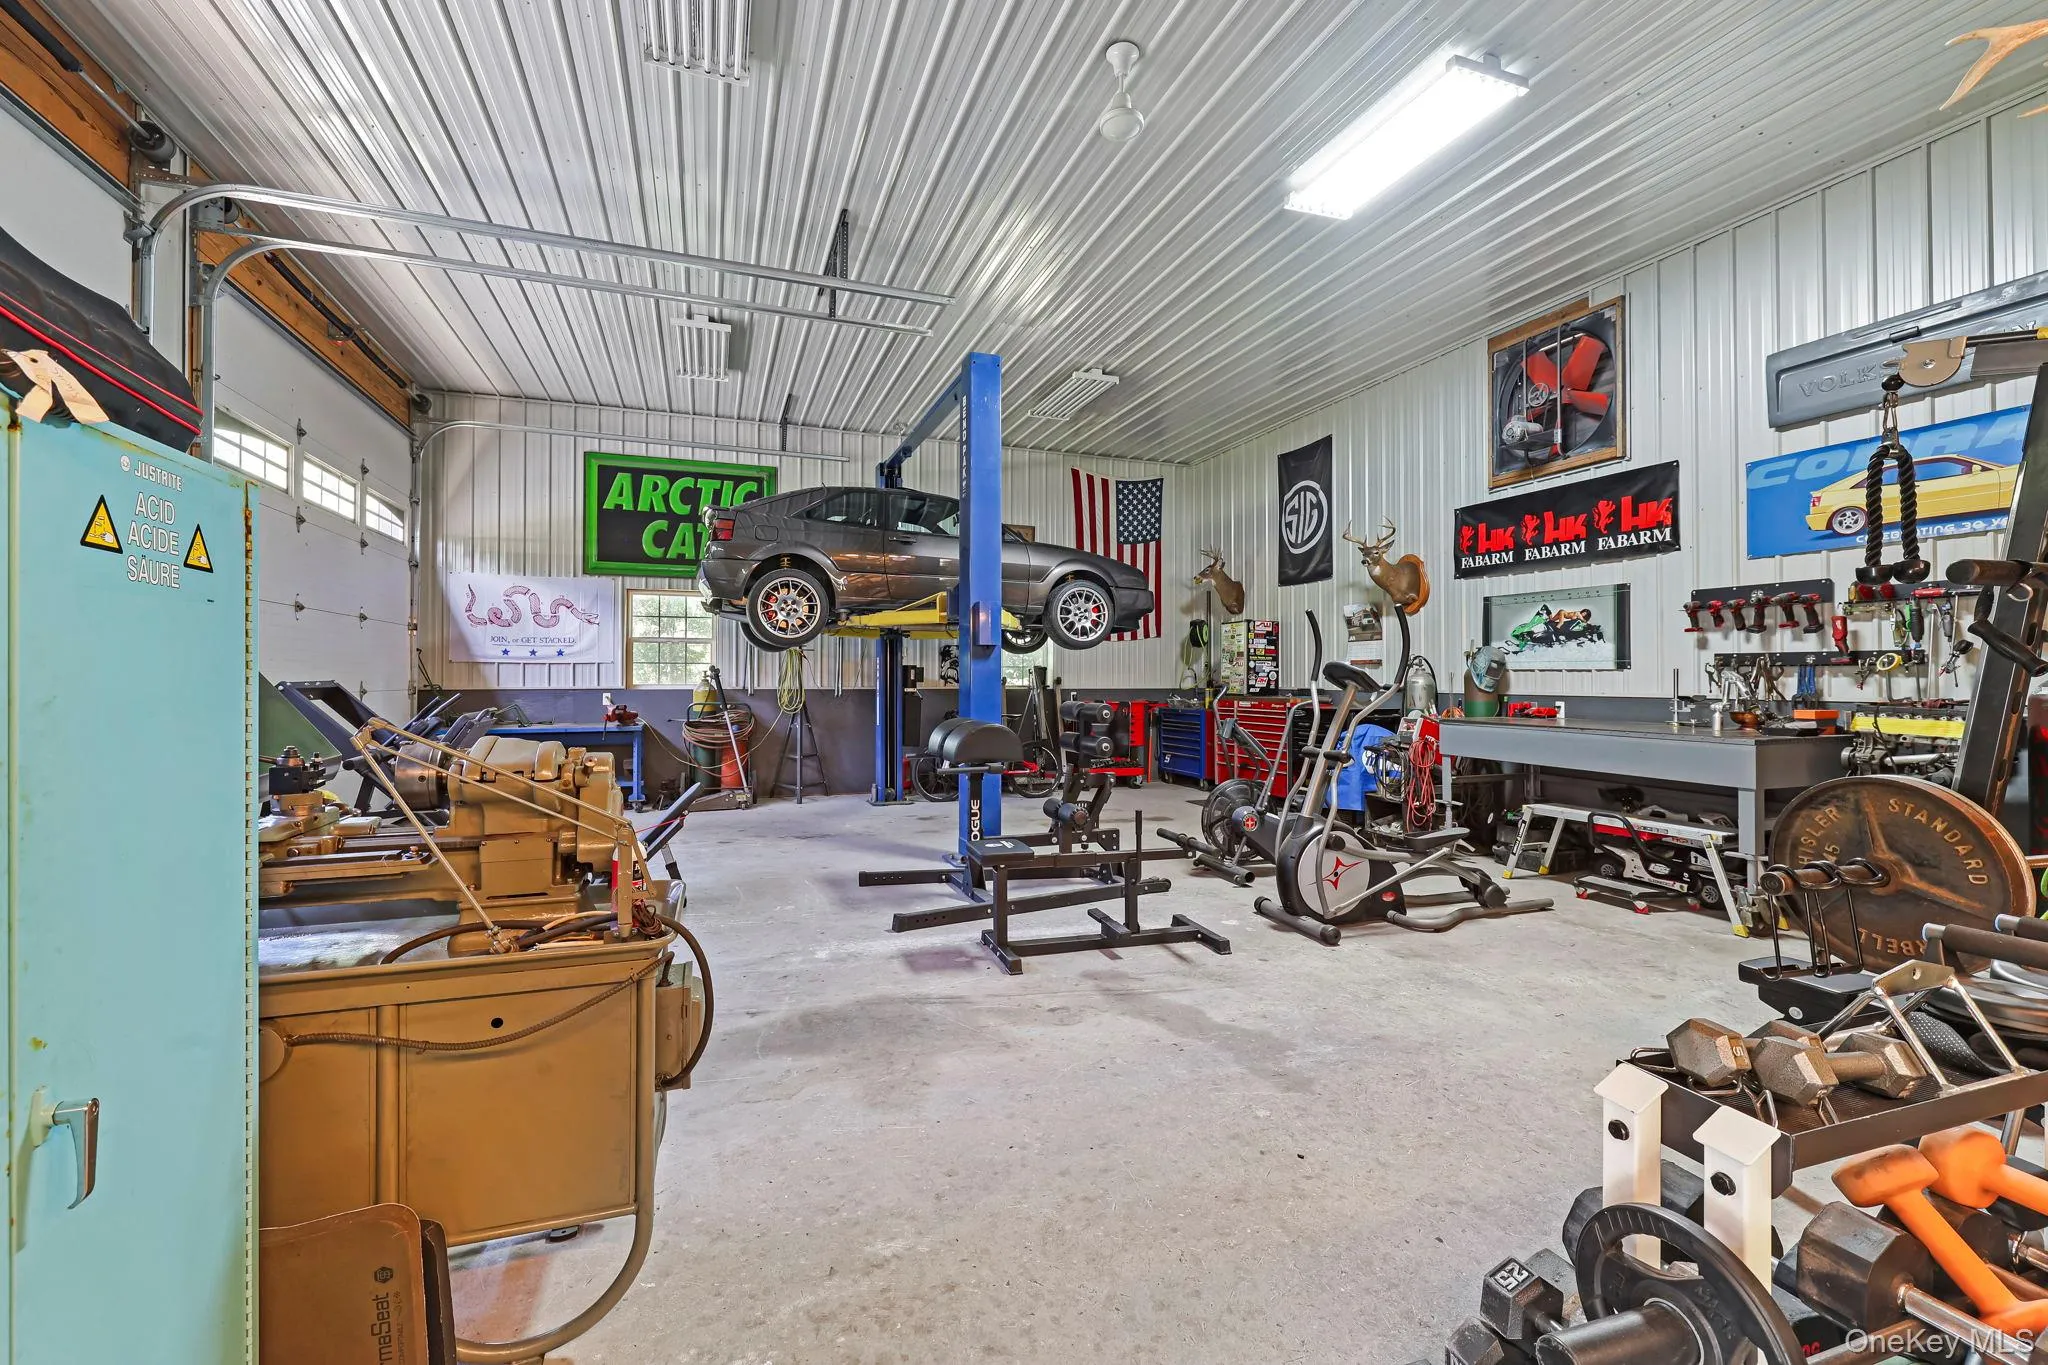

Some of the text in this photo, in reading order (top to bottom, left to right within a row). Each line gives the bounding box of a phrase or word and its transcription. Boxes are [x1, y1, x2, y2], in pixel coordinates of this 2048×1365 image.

[134, 460, 182, 491] JUSTRITE
[135, 491, 175, 525] ACID
[602, 472, 758, 516] ARCTIC
[1285, 490, 1319, 544] SIG
[1856, 523, 1955, 543] CEBTING
[127, 520, 180, 556] ACIDE
[1524, 540, 1586, 561] FABARM
[1597, 527, 1673, 551] FABARM
[127, 554, 181, 589] SÄURE
[1461, 551, 1515, 569] FABARM
[521, 636, 537, 644] GET
[970, 799, 980, 842] OGUE
[1798, 806, 1841, 865] HISLER
[1888, 798, 1989, 884] STANDARD
[371, 1292, 393, 1365] maSeat
